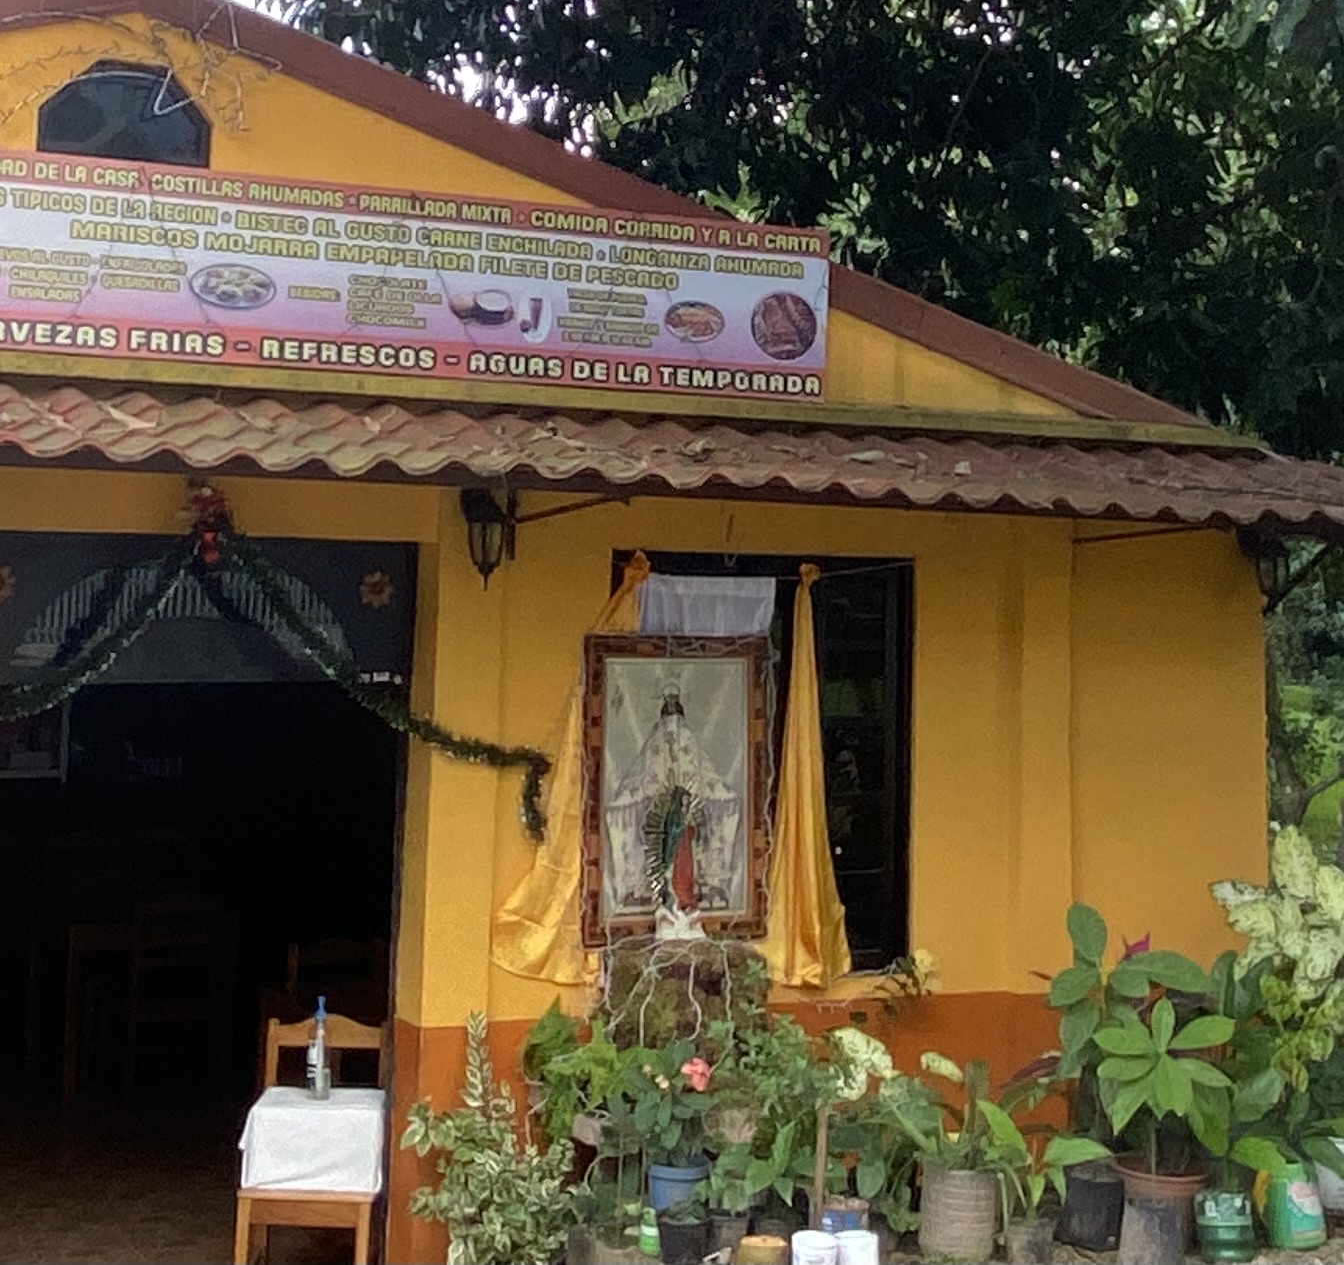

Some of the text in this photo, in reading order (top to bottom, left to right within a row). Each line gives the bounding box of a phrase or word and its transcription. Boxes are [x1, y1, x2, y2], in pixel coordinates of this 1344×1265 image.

[11, 189, 86, 214] TIPICOS
[90, 195, 118, 217] DE
[121, 199, 146, 219] LA
[150, 202, 218, 226] REGION
[236, 209, 308, 234] BISTEC
[313, 218, 340, 238] AL
[345, 220, 412, 244] GUSTO
[417, 227, 482, 250] CARNE
[486, 235, 593, 260] ENCHILADA
[609, 245, 711, 271] LONGANIZA
[715, 255, 804, 279] AHUMADA
[34, 162, 59, 180] DE
[64, 164, 87, 183] LA
[93, 167, 140, 189] CASA
[152, 172, 244, 198] COSTILLAS
[248, 184, 345, 209] AHUMADAS
[461, 203, 512, 224] MIXTA
[530, 210, 609, 234] COMIDA
[614, 218, 695, 242] CORRIDA
[700, 228, 713, 242] Y
[718, 230, 731, 245] A
[737, 233, 758, 248] LA
[764, 235, 821, 253] CARTA
[70, 220, 680, 291] MARISCOS MOJARRA EMPAPELADA FILETE DE PESCADO
[128, 328, 226, 356] FRIAS
[259, 336, 436, 371] REFRESCOS
[467, 349, 564, 379] AGUAS
[571, 358, 610, 381] DE
[616, 362, 652, 384] LA
[658, 366, 823, 397] TEMPORADA
